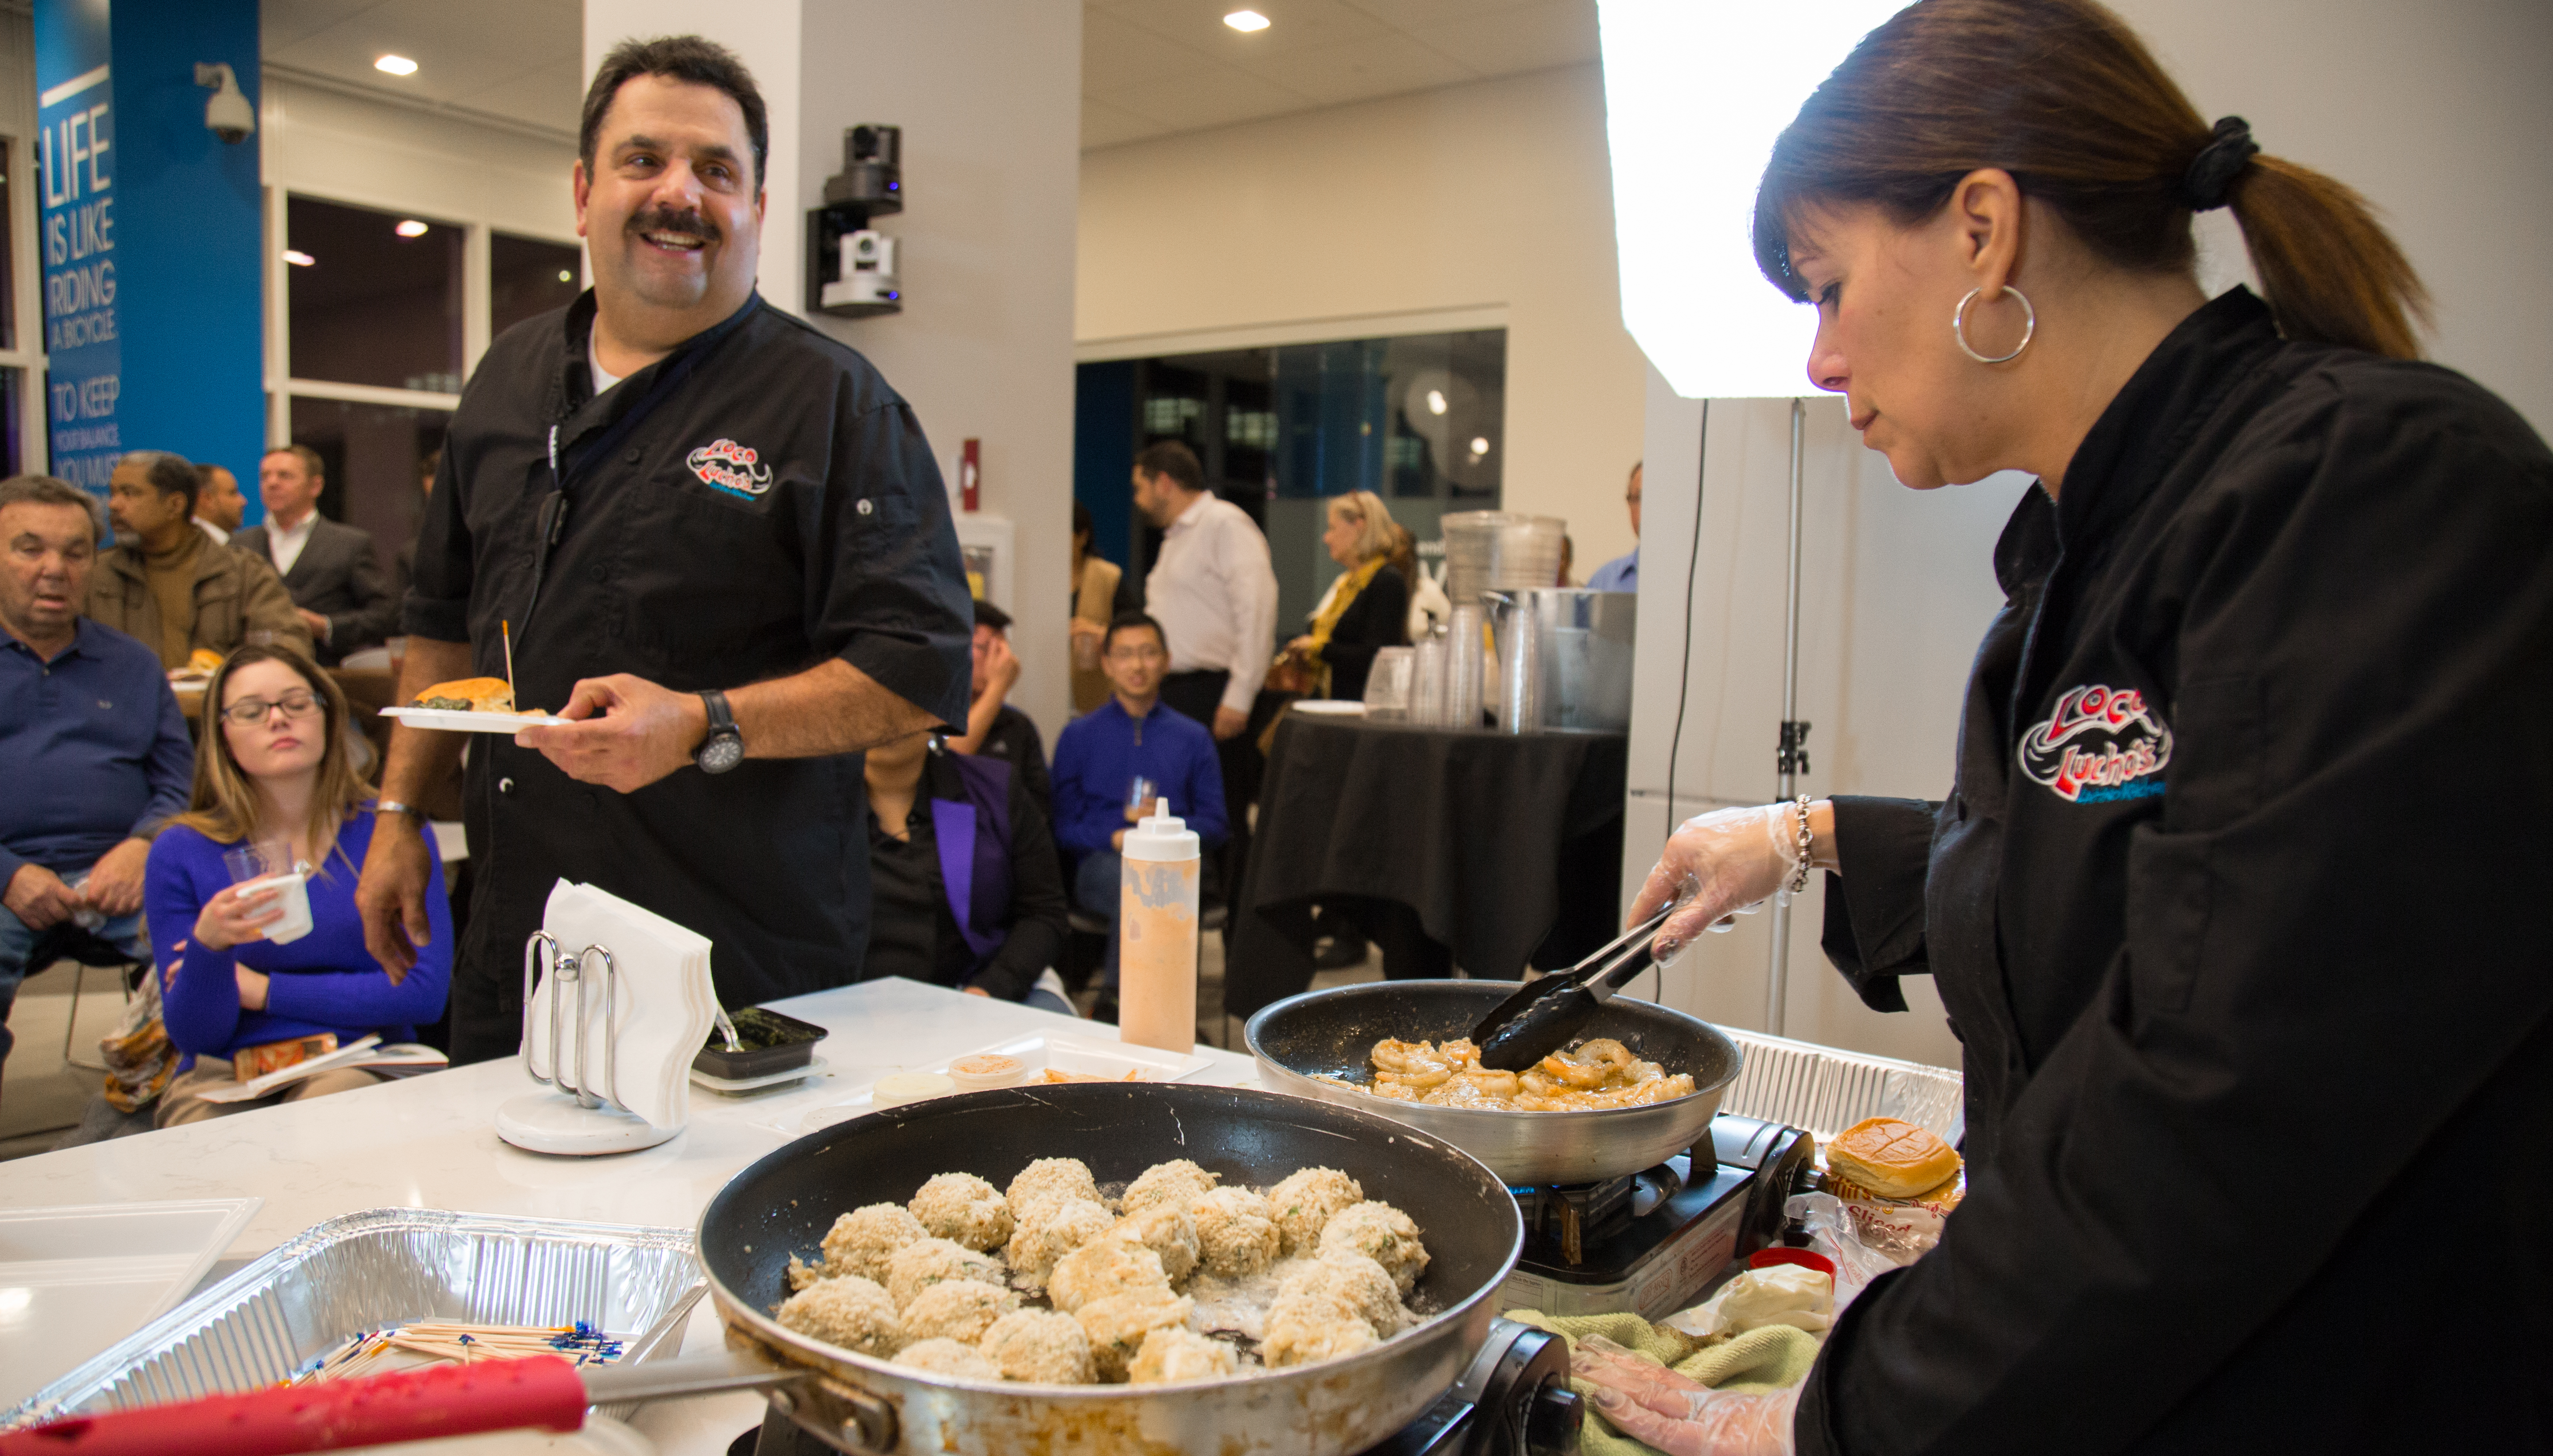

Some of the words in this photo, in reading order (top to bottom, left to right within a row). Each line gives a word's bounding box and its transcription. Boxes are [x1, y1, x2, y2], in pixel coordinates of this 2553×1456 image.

[43, 102, 111, 209] LIFE
[48, 213, 67, 266] IS
[69, 197, 114, 261] LIKE
[48, 259, 116, 317] RIDING
[52, 381, 77, 422] TO
[78, 374, 121, 418] KEEP
